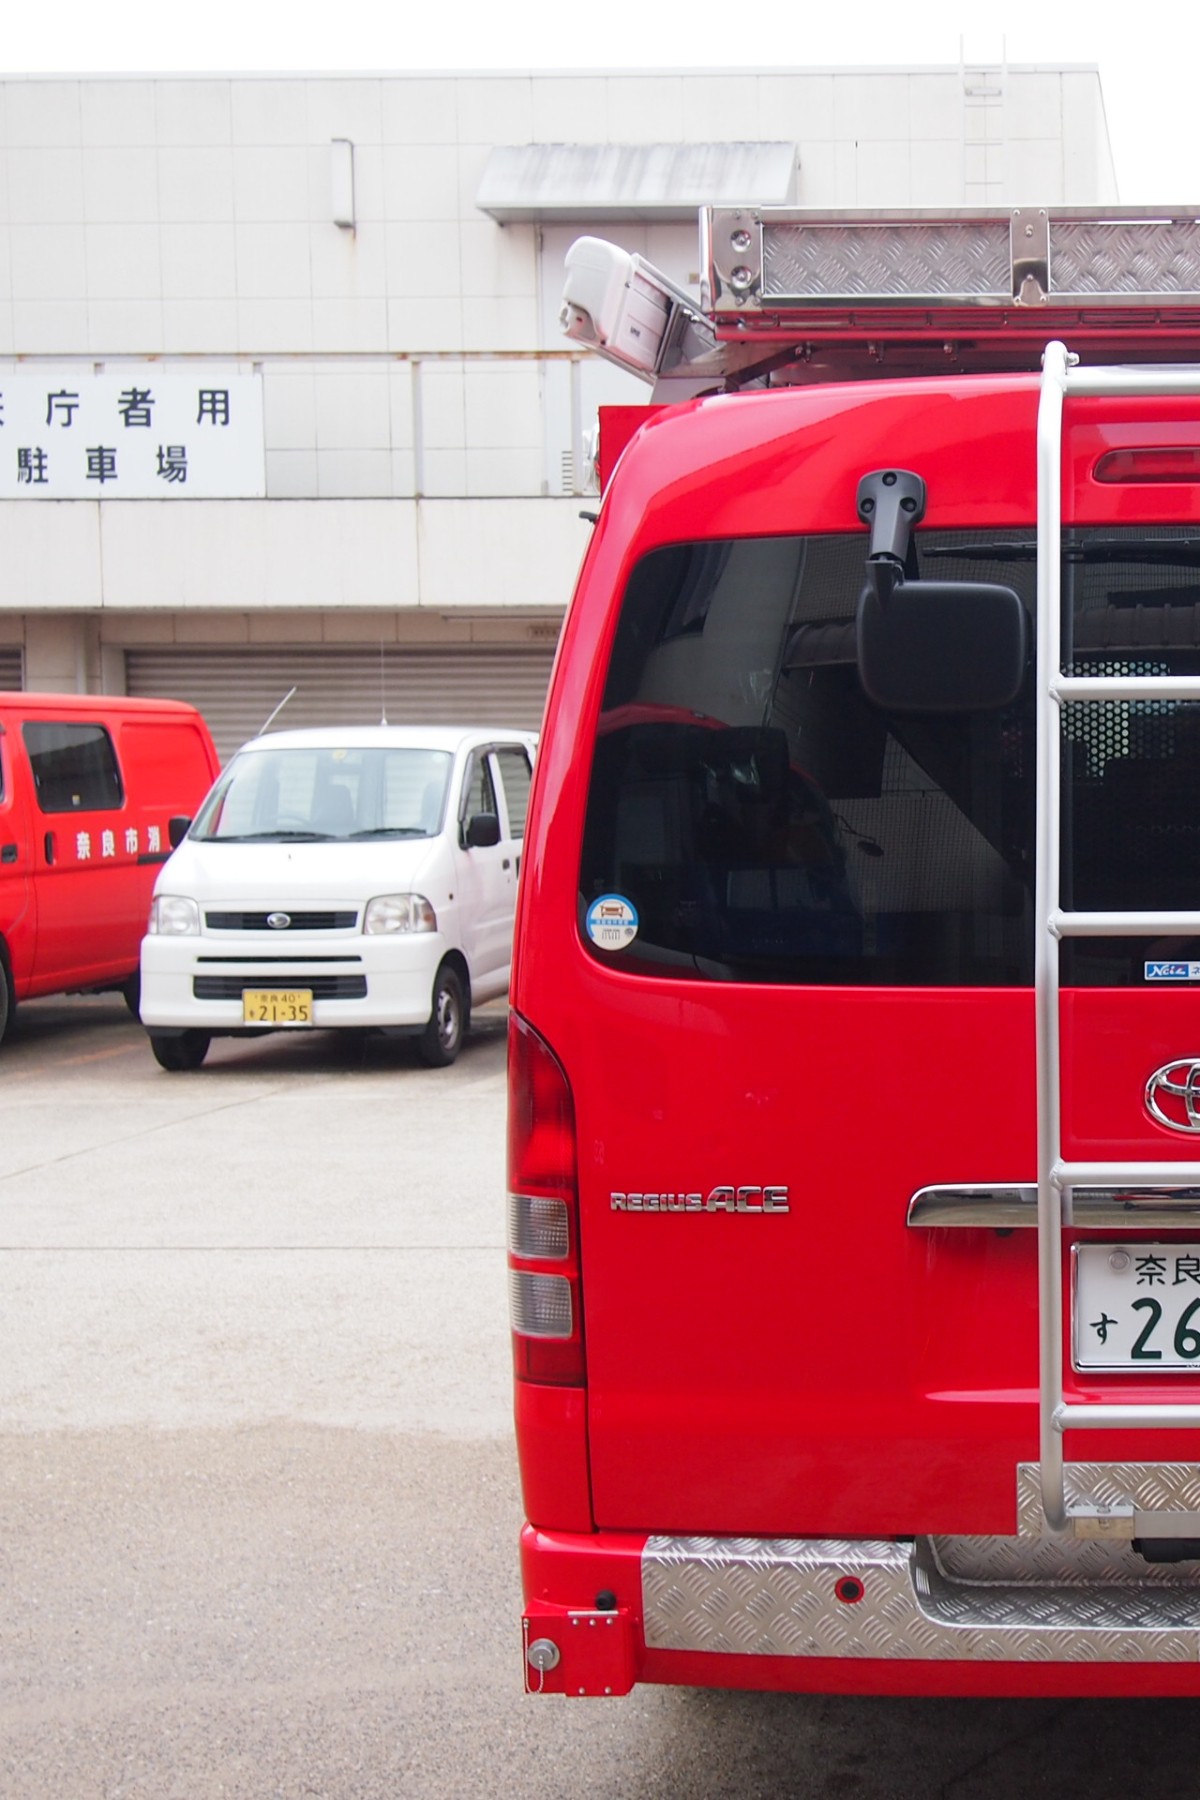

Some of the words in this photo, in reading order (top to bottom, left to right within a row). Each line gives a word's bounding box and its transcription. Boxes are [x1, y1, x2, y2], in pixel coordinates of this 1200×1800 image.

[17, 445, 188, 484] 駐車場
[76, 825, 173, 860] 奈良市消
[259, 1004, 308, 1022] 21-35
